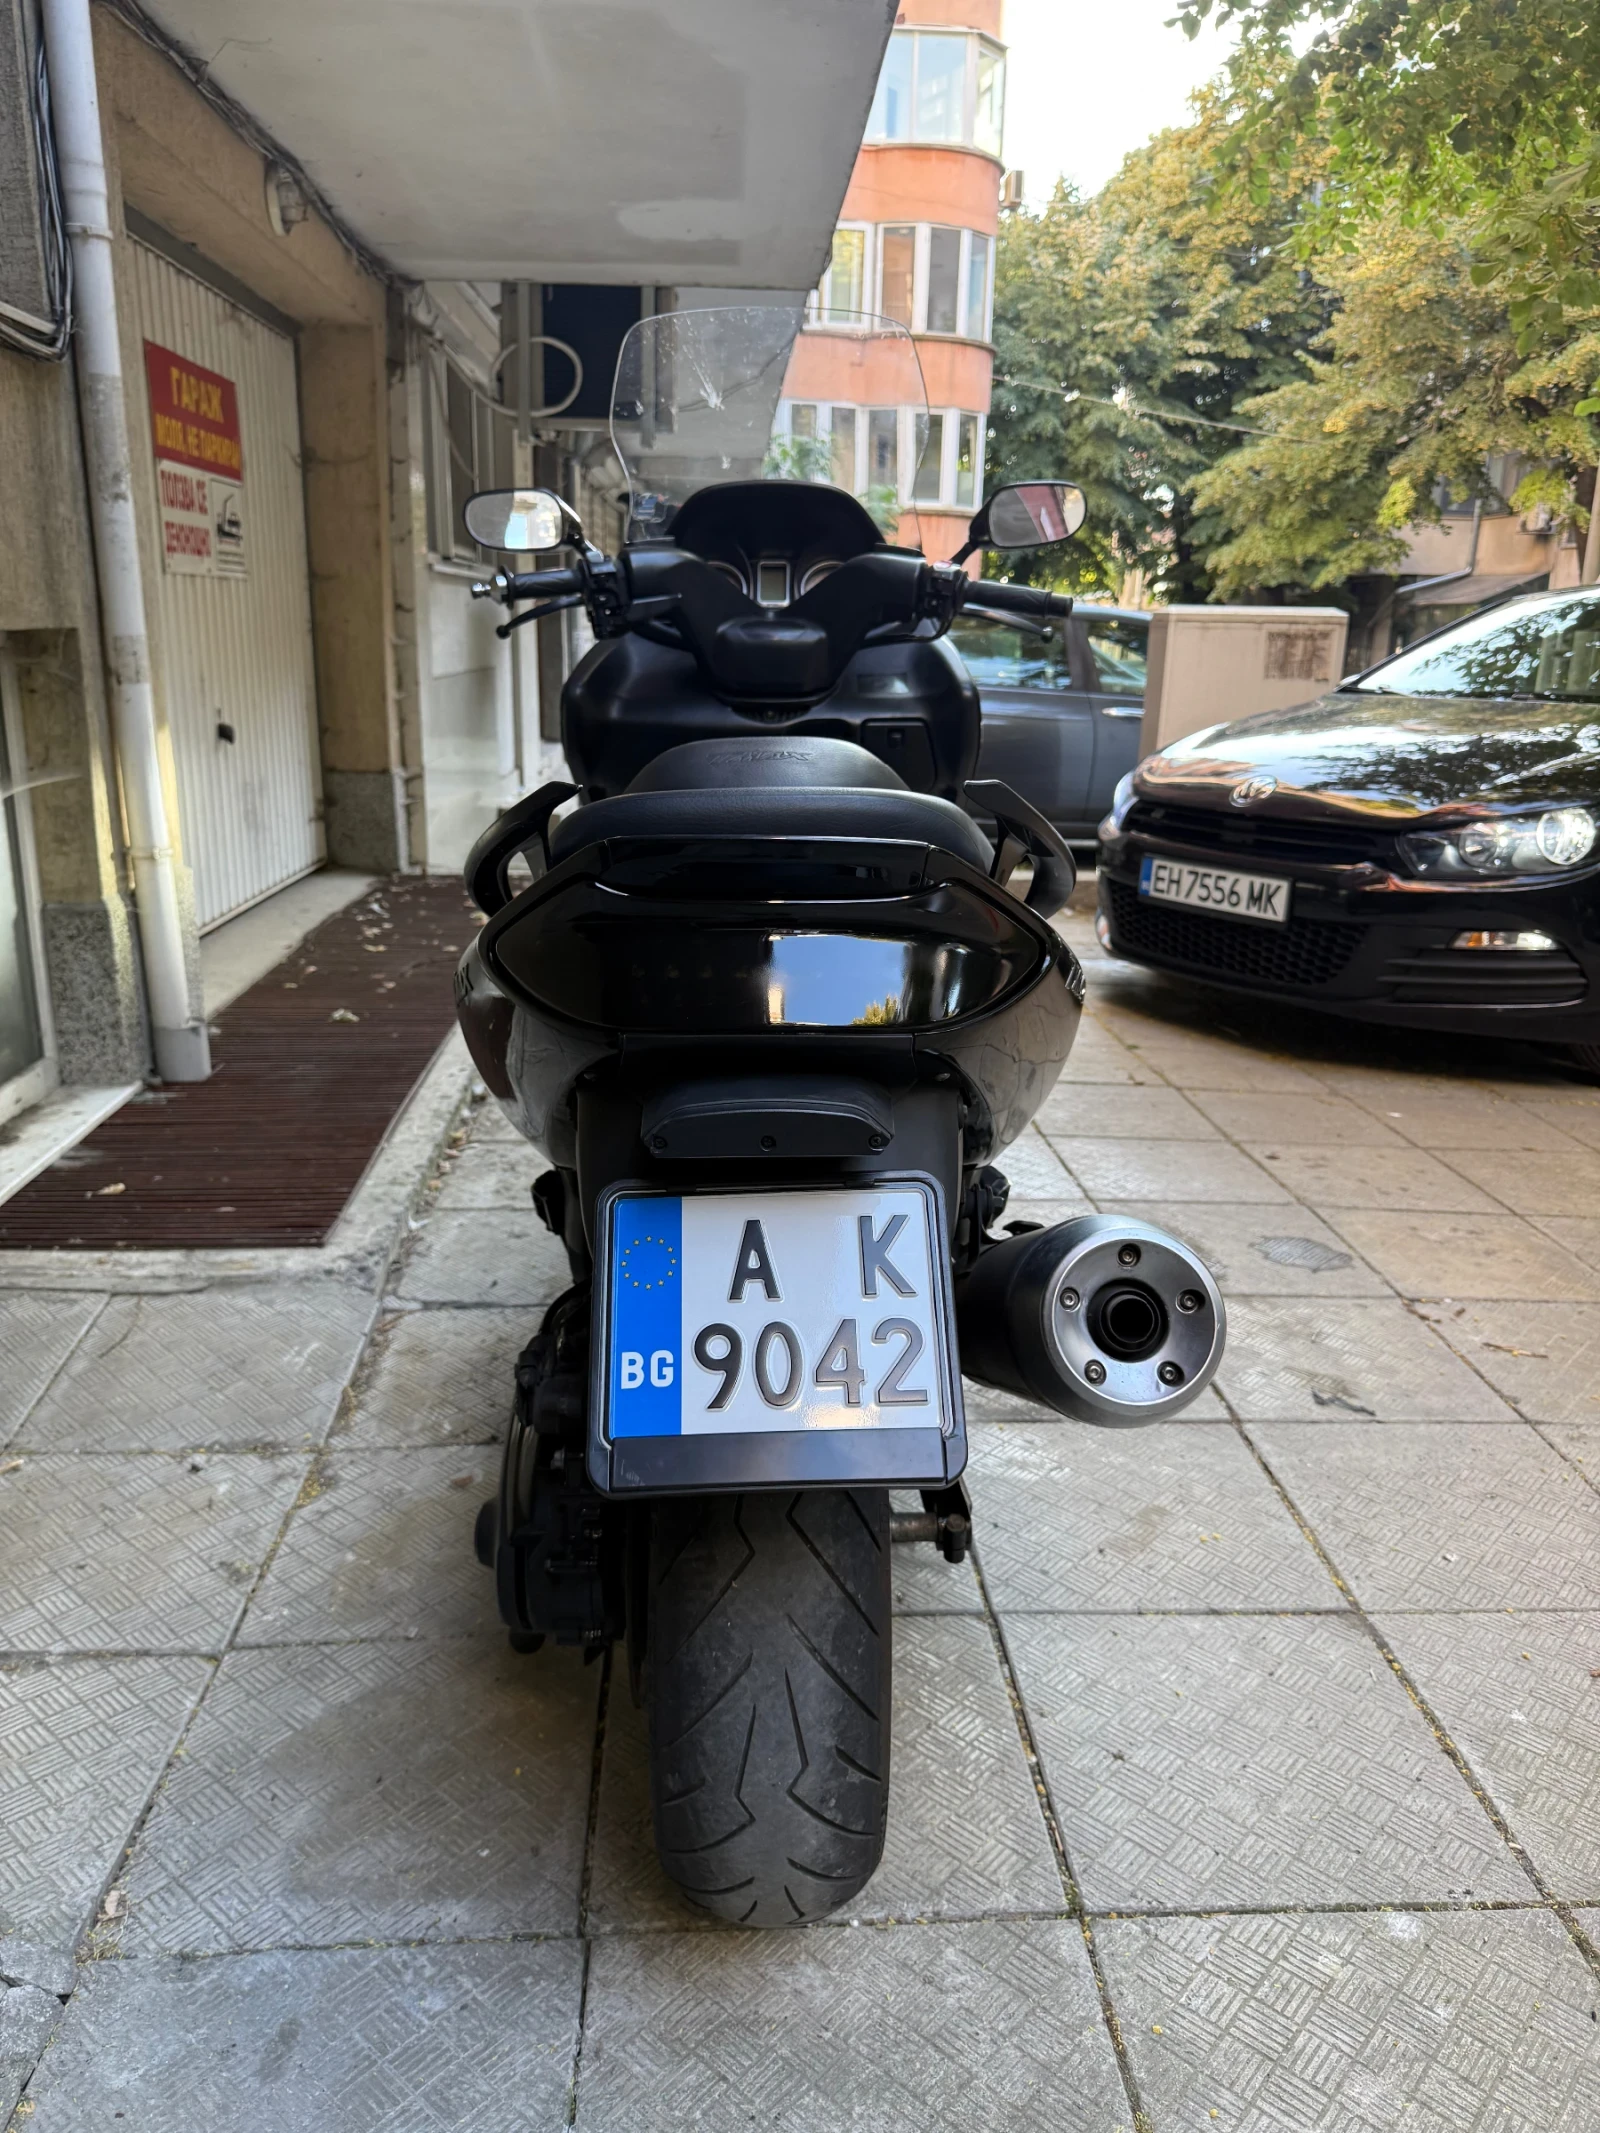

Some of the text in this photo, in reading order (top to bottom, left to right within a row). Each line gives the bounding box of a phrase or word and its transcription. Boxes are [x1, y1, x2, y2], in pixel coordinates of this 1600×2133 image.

[170, 366, 224, 424] ГАРАЖ
[728, 1213, 918, 1301] A K
[620, 1349, 675, 1390] BG
[692, 1316, 929, 1411] 9042
